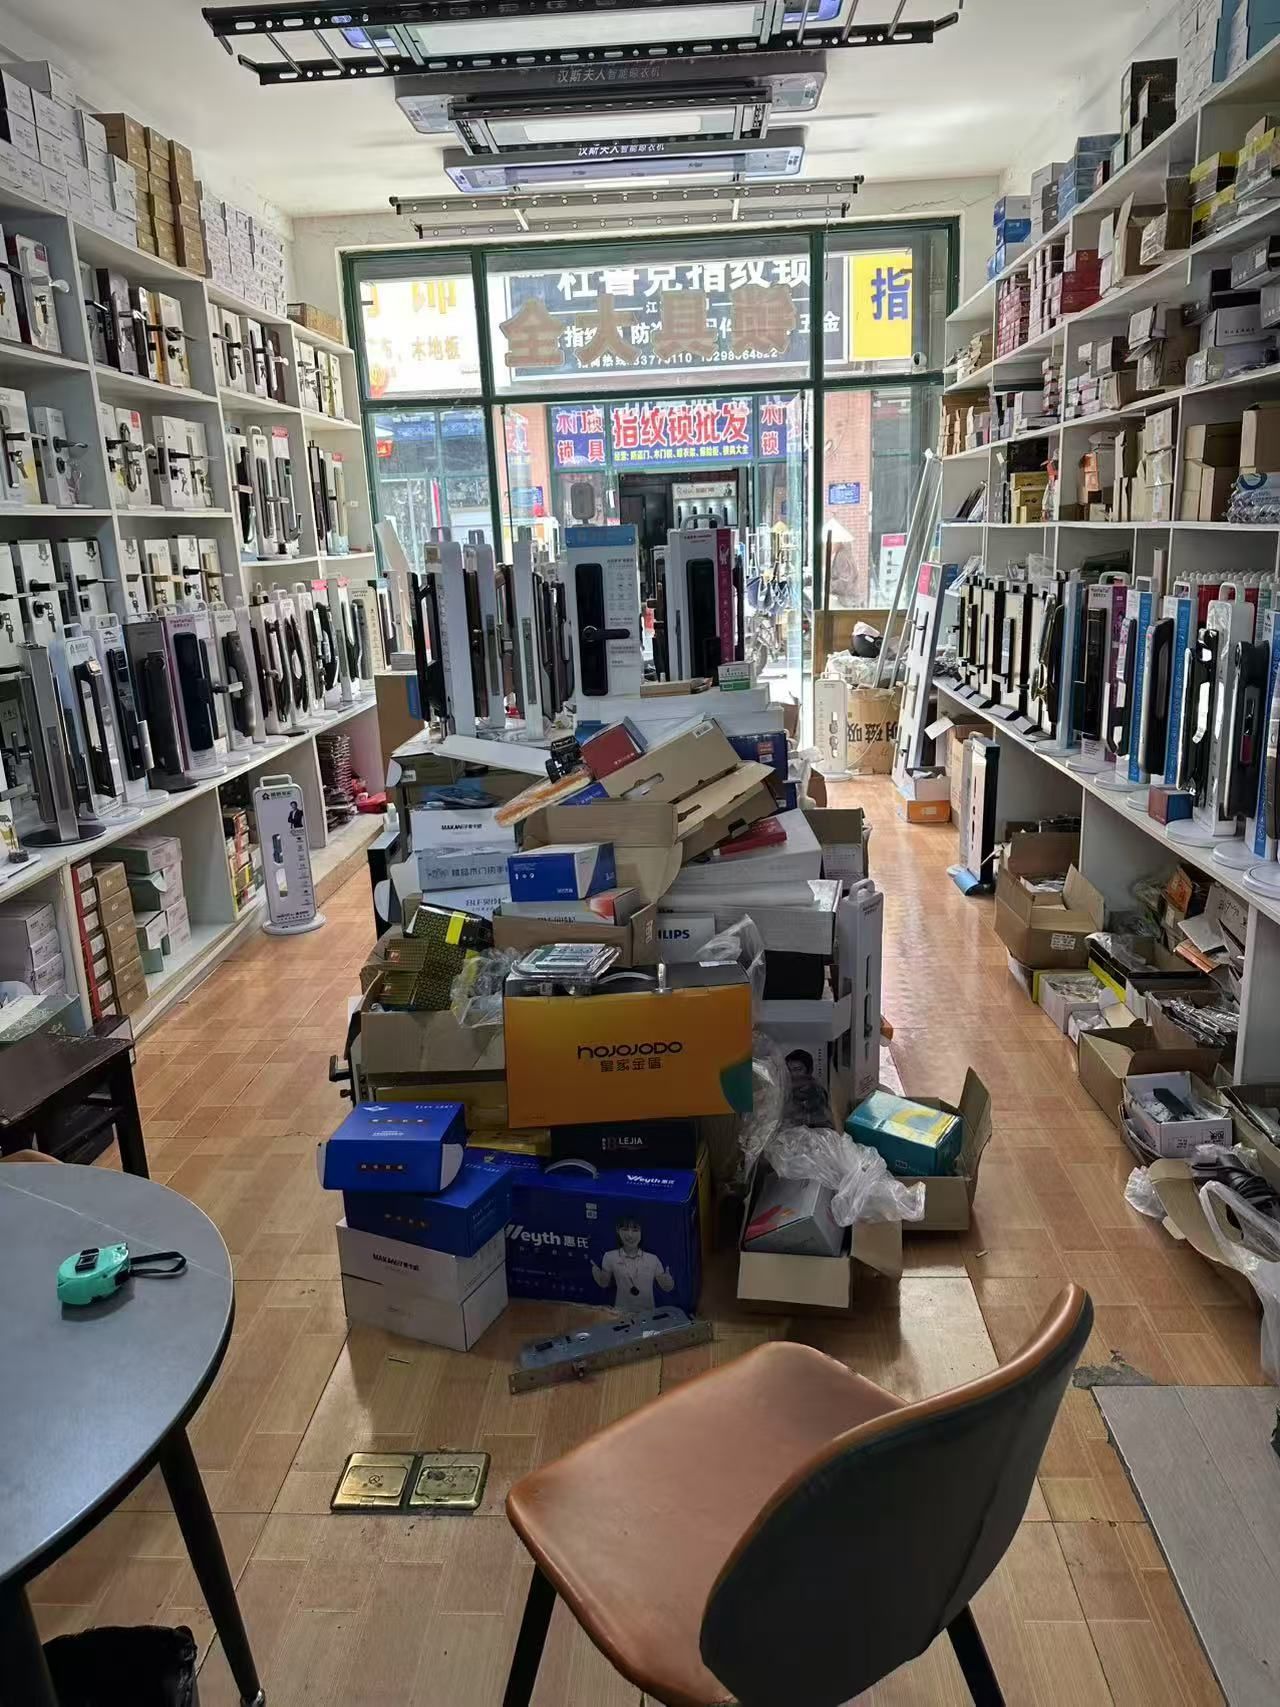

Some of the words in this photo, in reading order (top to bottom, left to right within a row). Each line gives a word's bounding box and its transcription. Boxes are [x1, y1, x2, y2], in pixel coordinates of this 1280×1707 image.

[870, 266, 912, 320] 指
[611, 402, 750, 449] 指纹锁批发
[600, 1057, 662, 1073] 皇家金盾
[618, 1137, 643, 1146] LEJIA
